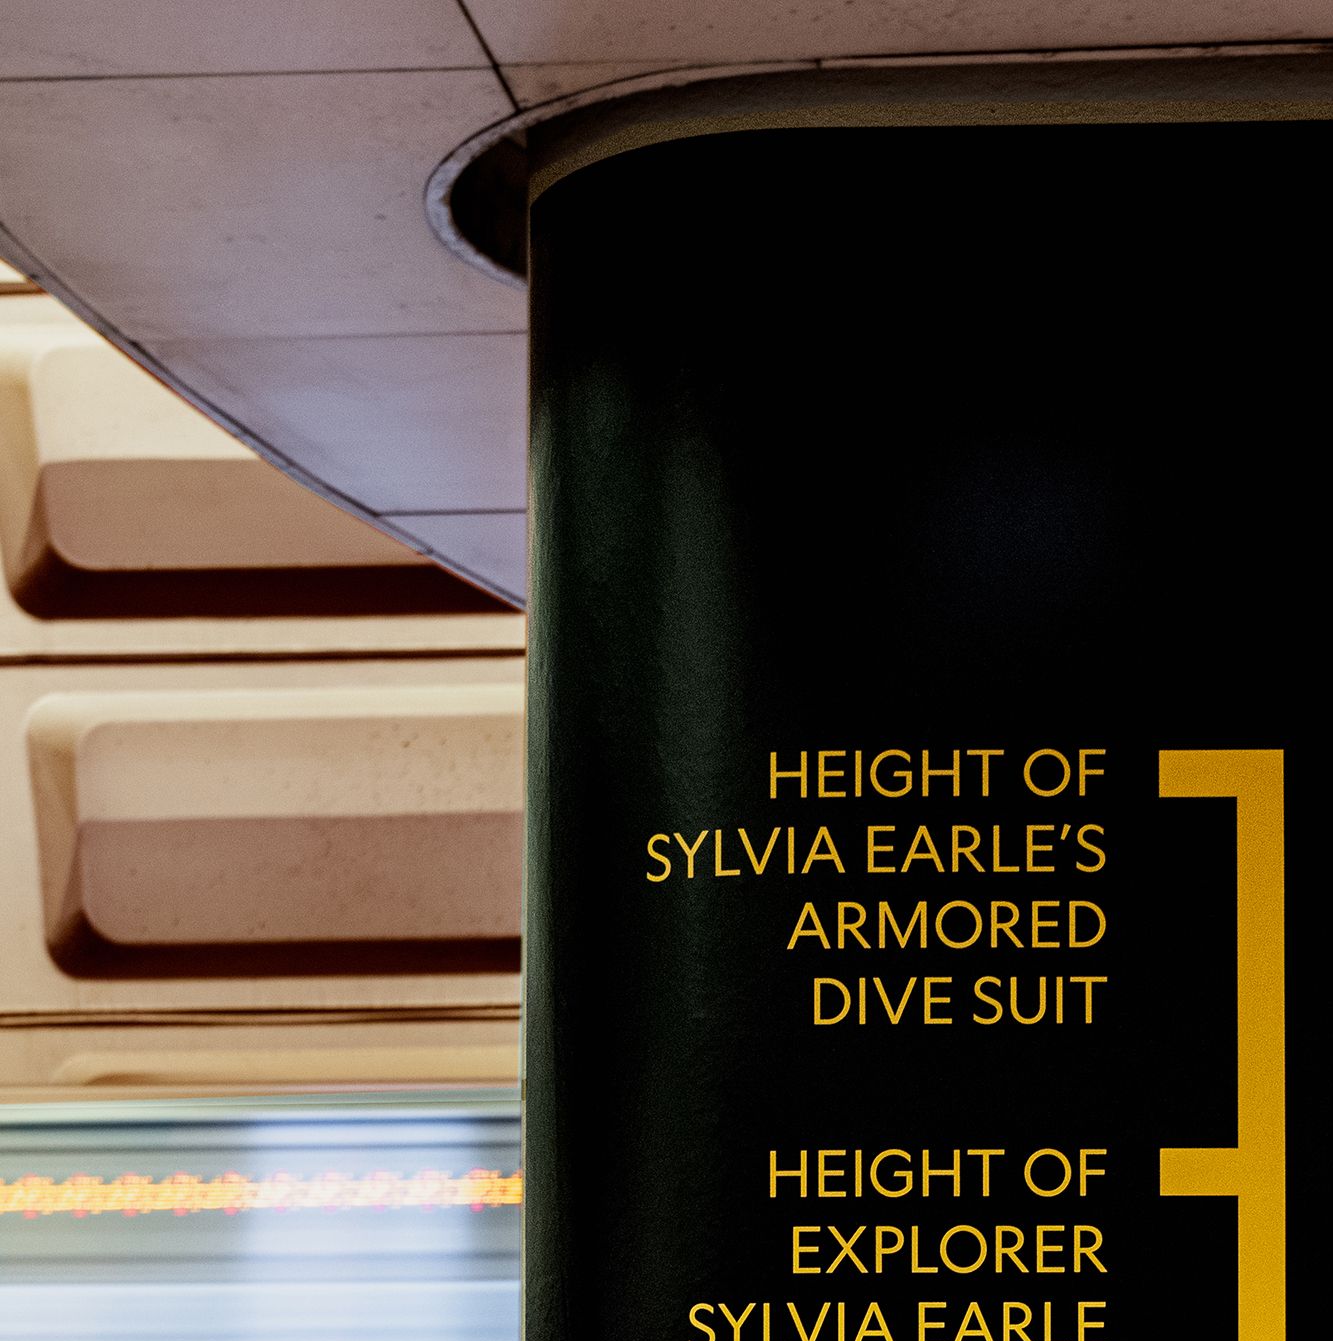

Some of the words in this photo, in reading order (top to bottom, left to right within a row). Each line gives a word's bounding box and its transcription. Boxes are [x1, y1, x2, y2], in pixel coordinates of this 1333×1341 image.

[770, 750, 1004, 798] HEIGHT
[1024, 749, 1106, 797] OF
[647, 827, 846, 882] SYLVIA
[868, 824, 1106, 873] EARLE'S
[787, 901, 1107, 950] ARMORED
[814, 977, 953, 1026] DIVE
[973, 976, 1108, 1025] SUIT
[770, 1149, 1005, 1197] HEIGHT
[1024, 1149, 1107, 1197] OF
[793, 1225, 1107, 1273] EXPLORER
